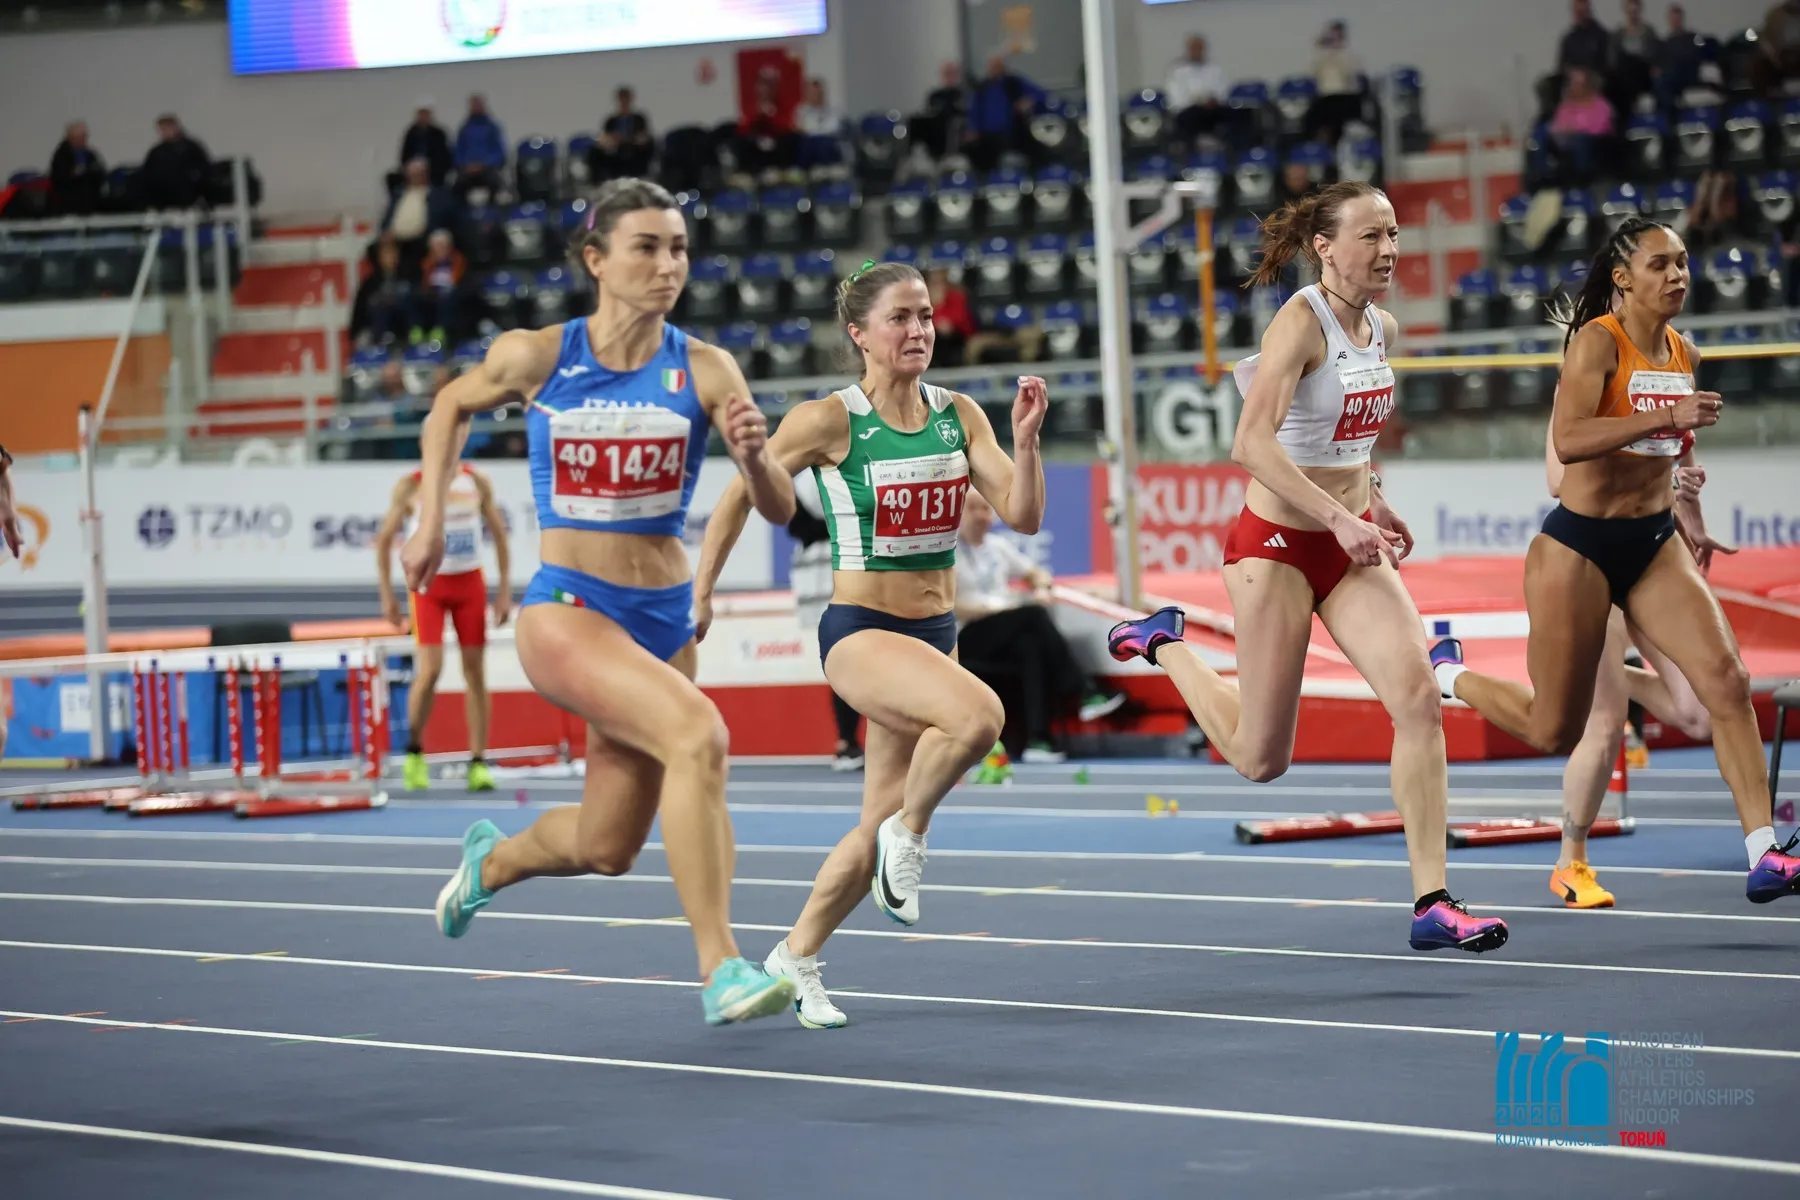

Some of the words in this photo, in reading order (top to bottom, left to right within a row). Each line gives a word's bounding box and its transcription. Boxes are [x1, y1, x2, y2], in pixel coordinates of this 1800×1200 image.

[1346, 397, 1362, 416] 40
[1153, 381, 1236, 455] G1
[1344, 418, 1354, 429] W
[559, 443, 597, 467] 40
[605, 443, 681, 484] 1424
[569, 469, 588, 483] W
[882, 488, 912, 509] 40
[187, 503, 292, 538] TZMO
[890, 512, 904, 525] W
